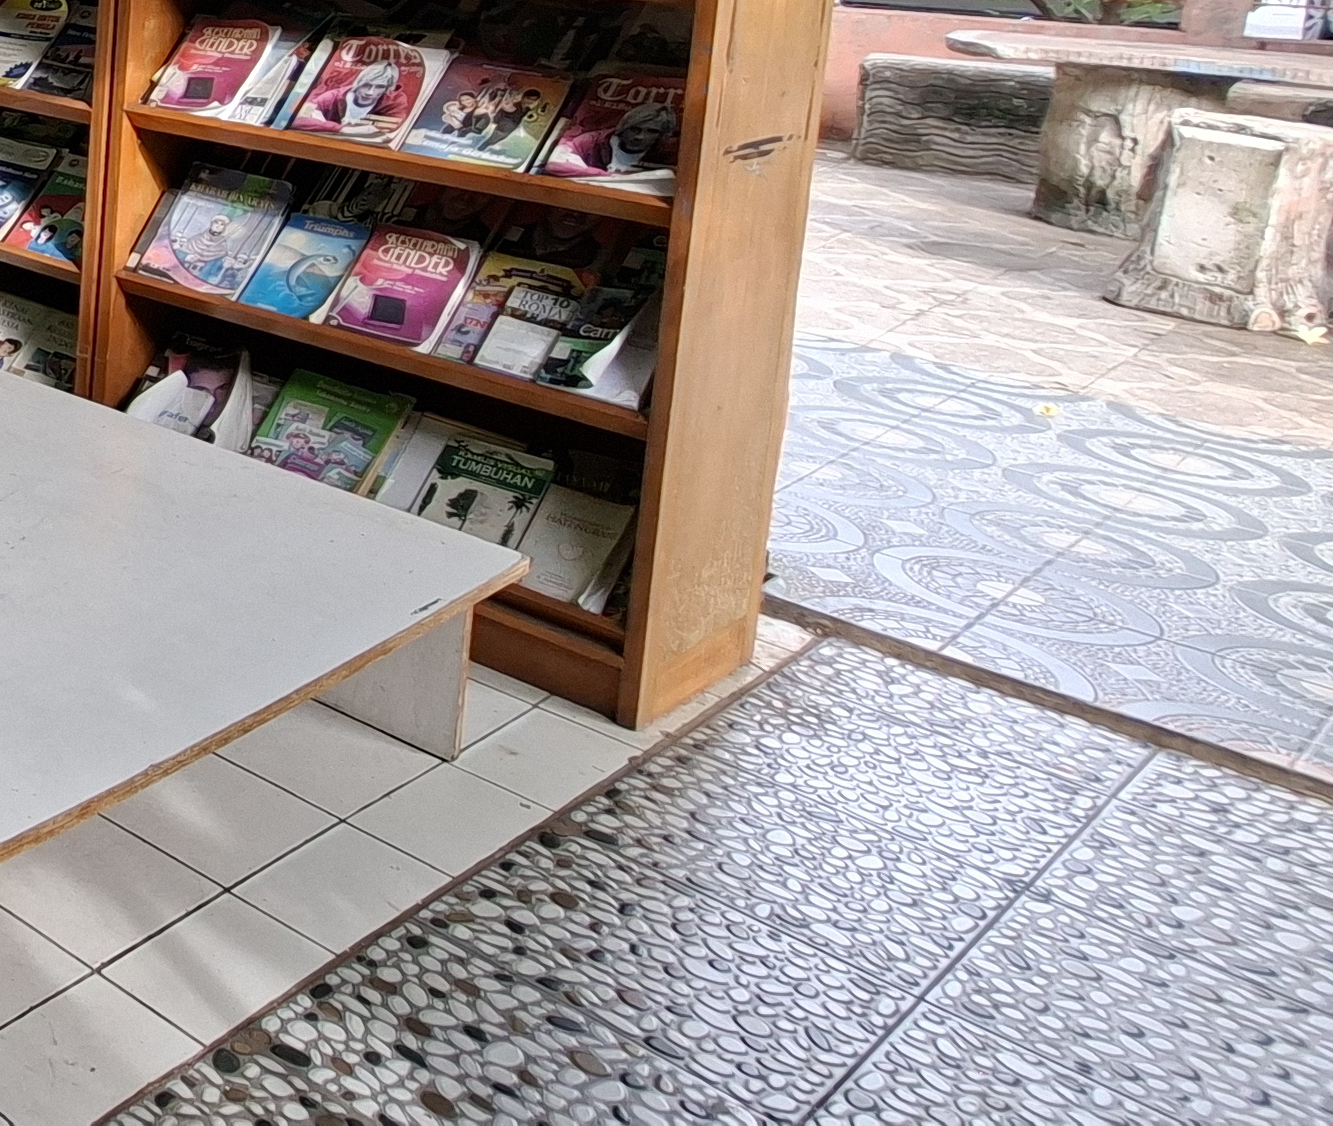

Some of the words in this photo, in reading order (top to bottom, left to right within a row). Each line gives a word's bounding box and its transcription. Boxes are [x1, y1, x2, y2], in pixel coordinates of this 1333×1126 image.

[194, 35, 258, 55] GENDER
[595, 77, 685, 102] Torr
[55, 176, 86, 188] Bahas
[378, 245, 456, 276] GENDER
[551, 297, 571, 309] 10
[450, 456, 535, 489] TUMBUHAN
